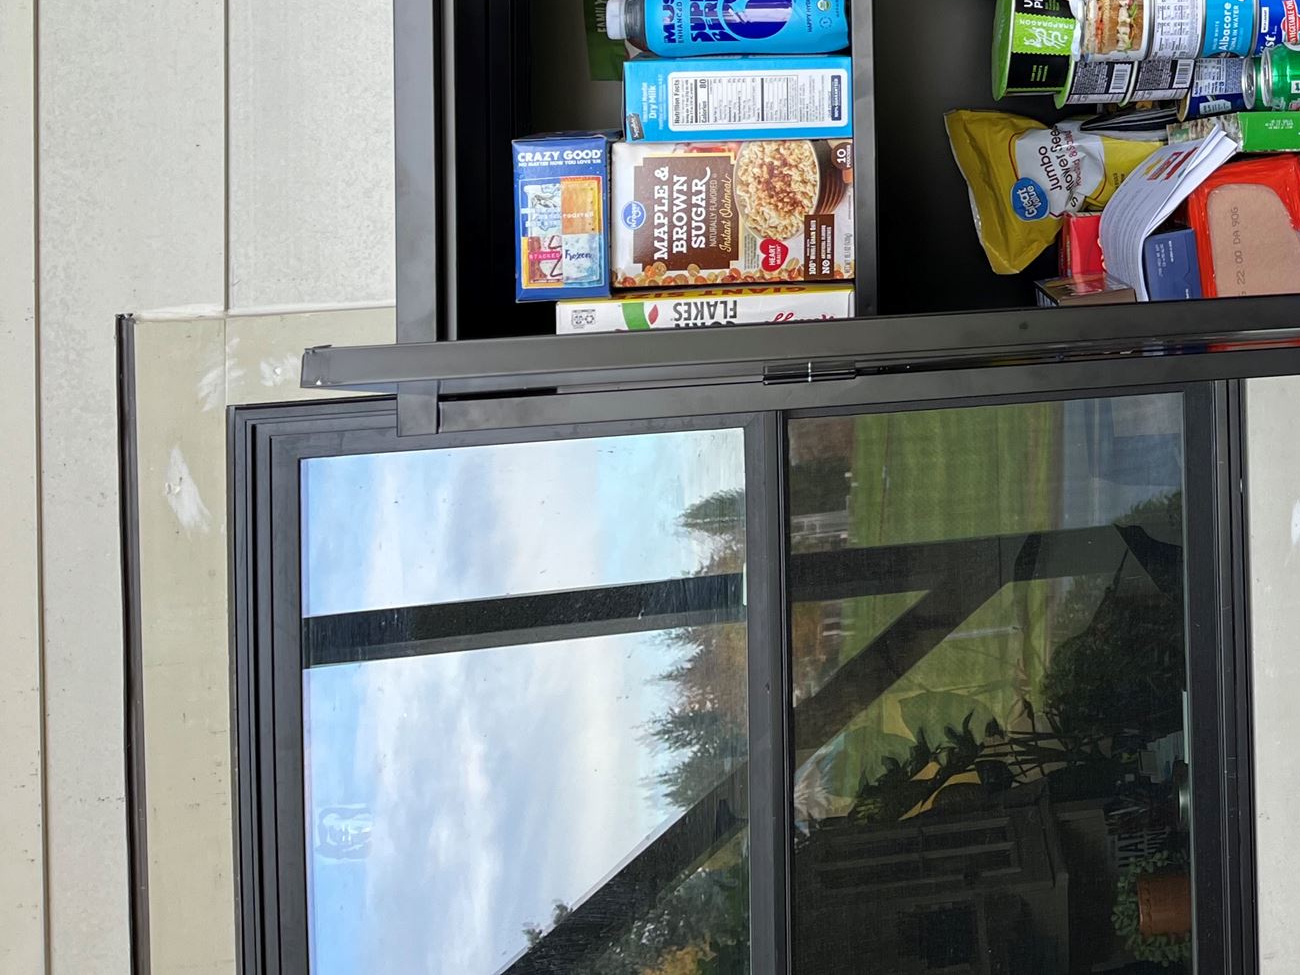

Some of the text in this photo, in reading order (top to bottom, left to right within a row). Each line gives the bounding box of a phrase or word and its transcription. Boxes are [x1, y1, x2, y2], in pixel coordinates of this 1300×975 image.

[1219, 2, 1232, 51] Albacore
[1228, 37, 1238, 50] TUNA
[700, 79, 706, 88] 80
[648, 85, 657, 119] Dry Milk
[518, 149, 601, 162] CRAZY GOOD
[837, 148, 846, 163] 10
[1038, 146, 1062, 191] Jumbo
[691, 167, 710, 248] SUGAR
[1016, 188, 1037, 217] Great
[1027, 186, 1042, 208] Value
[654, 166, 668, 260] MAPLE &
[672, 175, 687, 253] BROWN
[719, 174, 733, 252] Instant Oatmeal
[768, 244, 777, 265] HEART
[821, 259, 831, 274] NO
[1234, 250, 1246, 285] 22 00
[673, 300, 737, 319] FLAKES
